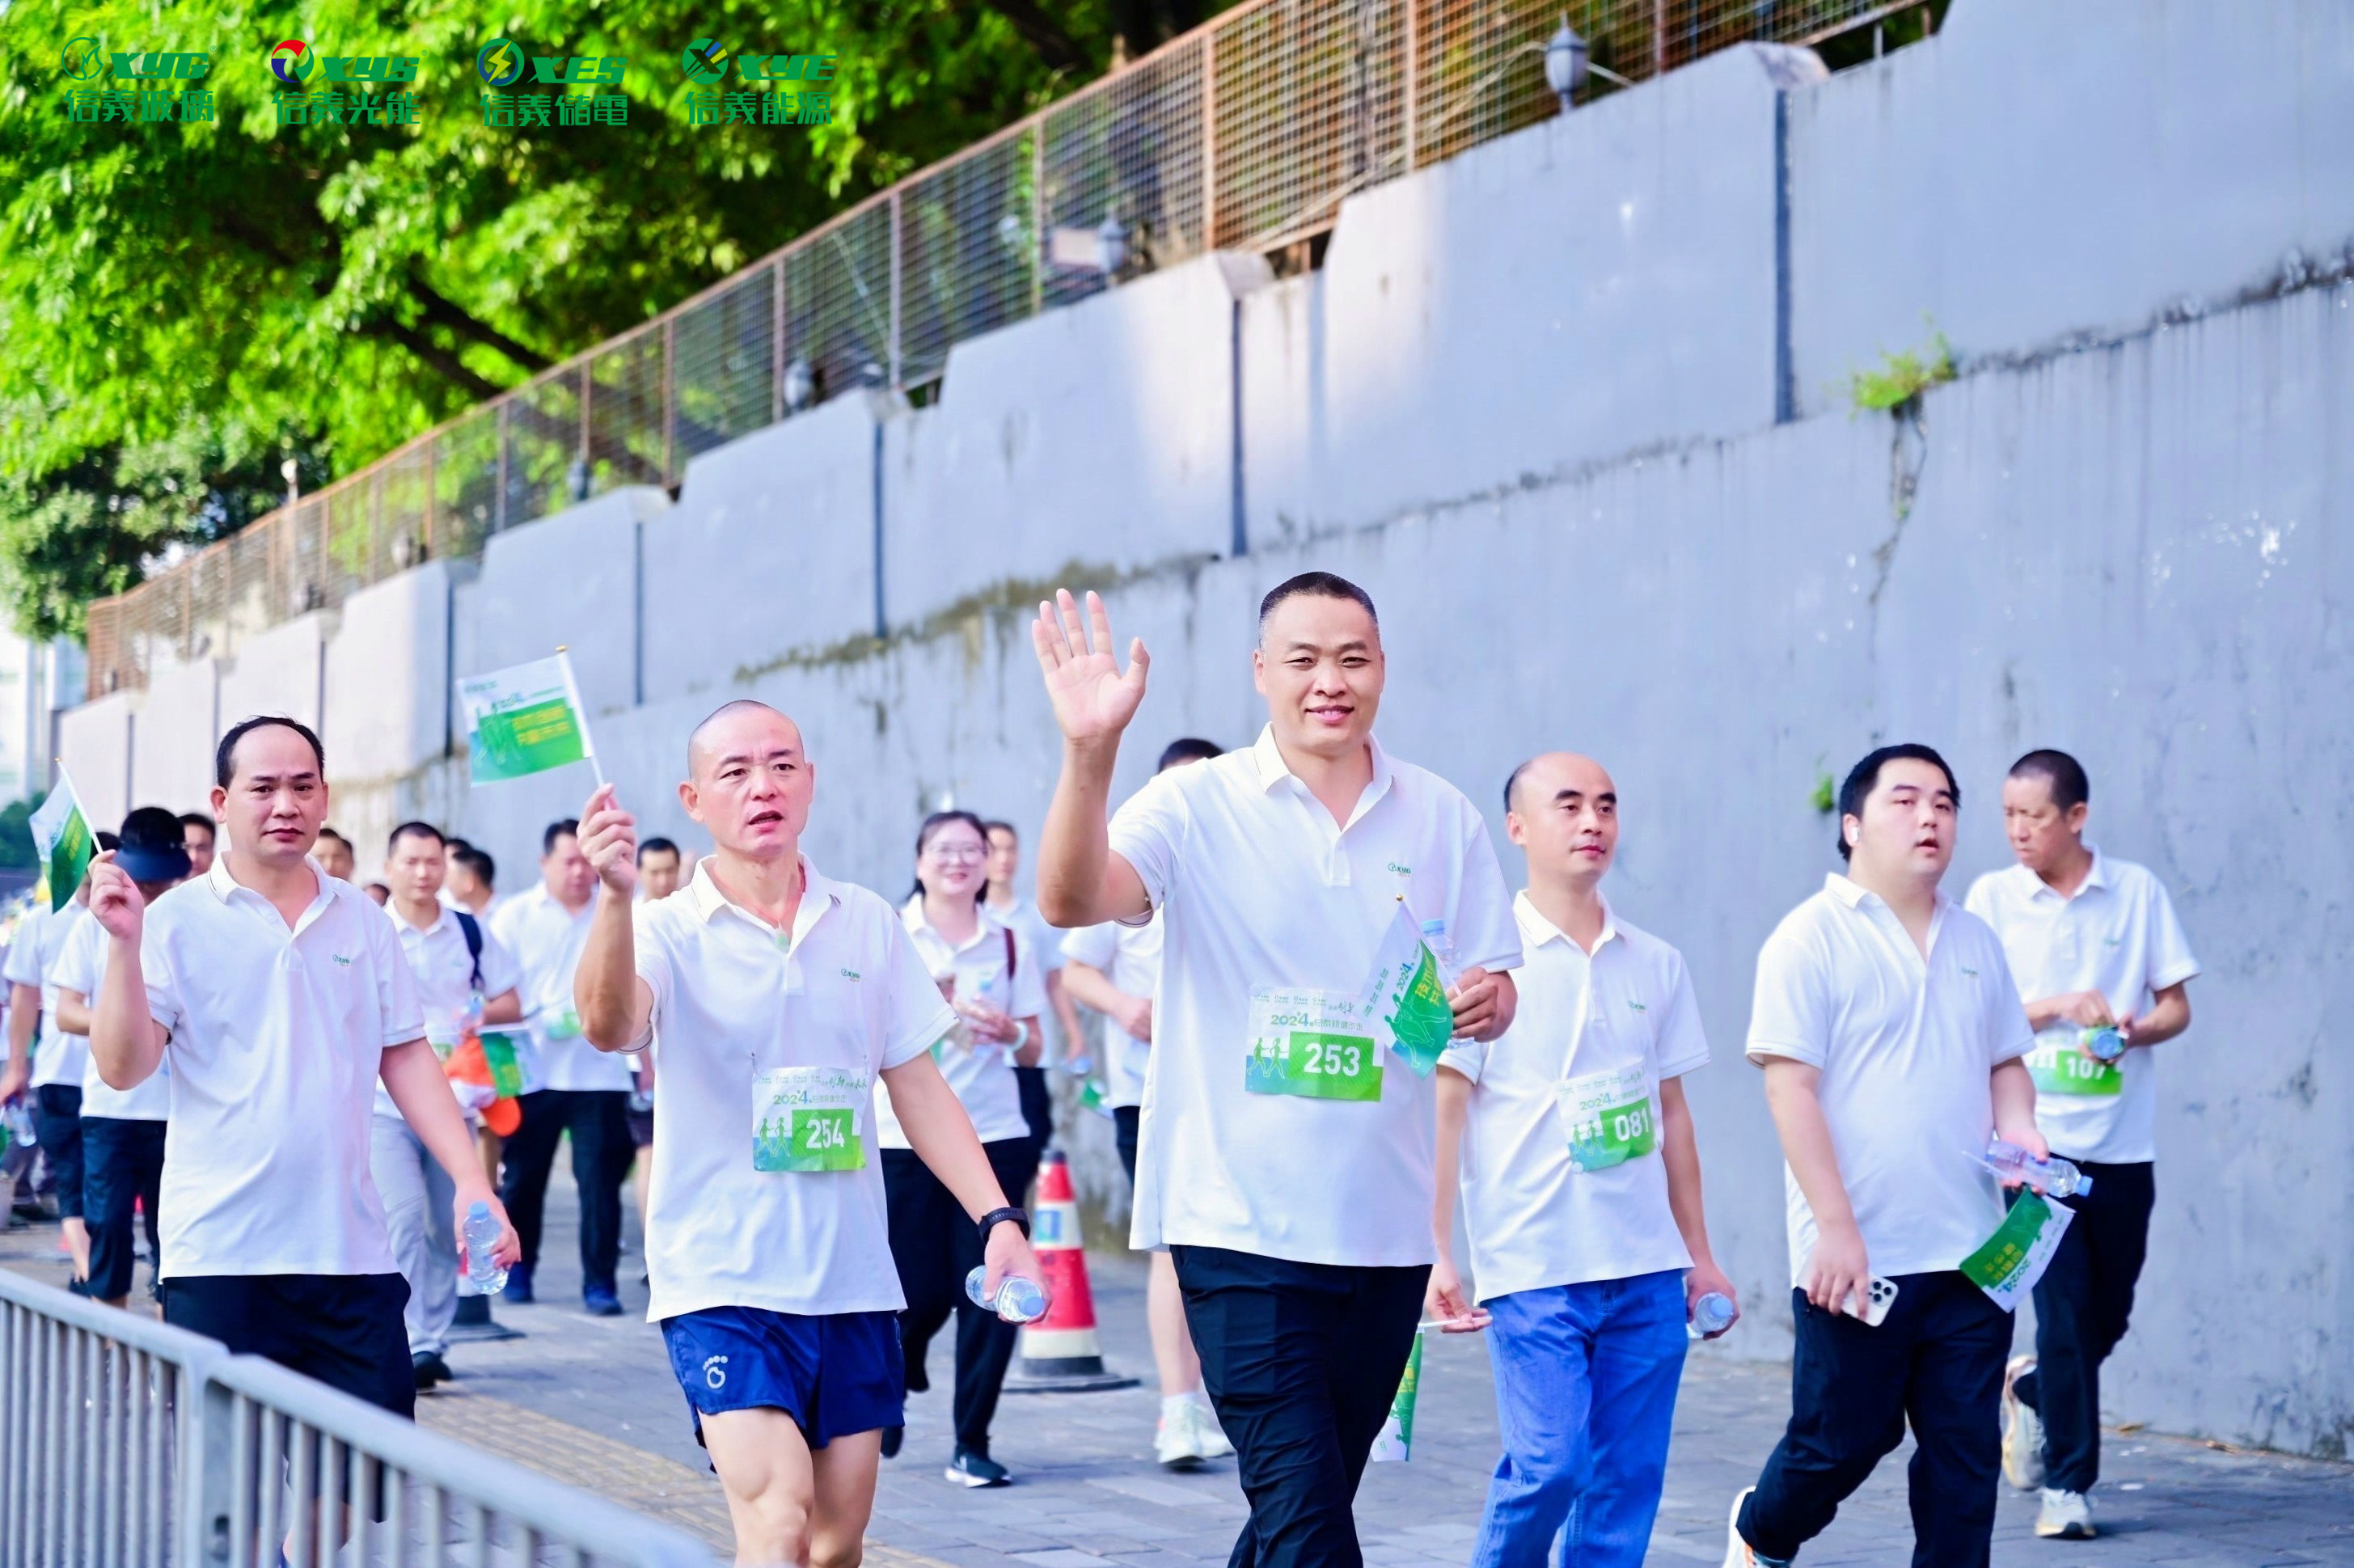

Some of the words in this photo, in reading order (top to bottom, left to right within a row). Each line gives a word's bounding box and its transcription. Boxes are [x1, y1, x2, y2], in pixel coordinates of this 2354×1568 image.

[1397, 962, 1414, 992] 2024
[1270, 1012, 1309, 1027] 2024
[1304, 1042, 1361, 1077] 253
[773, 1090, 809, 1105] 2024
[1579, 1092, 1612, 1111] 2024
[805, 1118, 845, 1149] 254
[1615, 1107, 1650, 1142] 081
[2002, 1260, 2031, 1293] 2024
